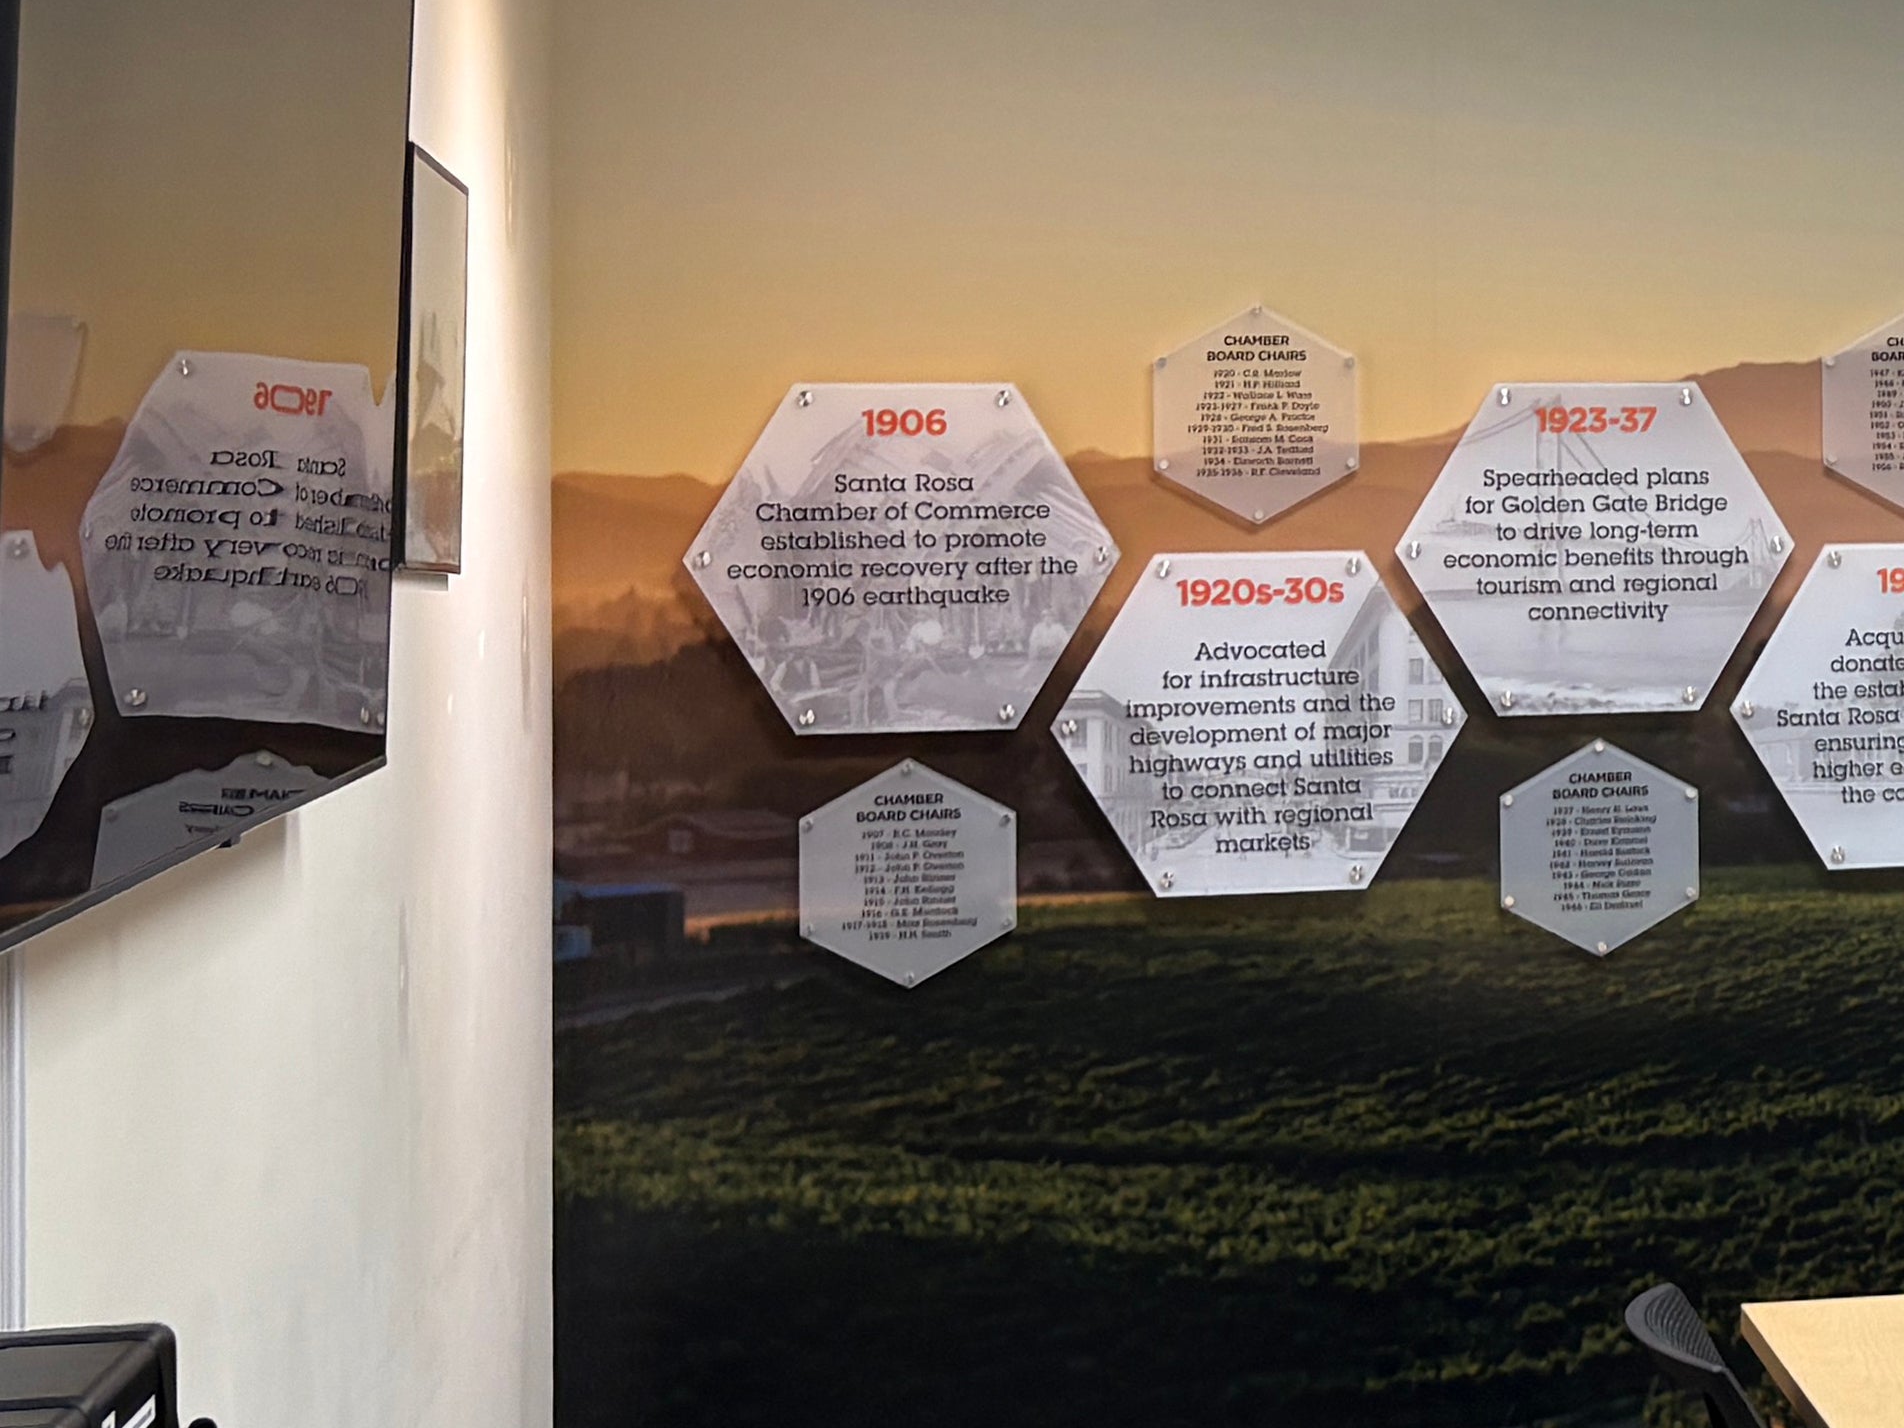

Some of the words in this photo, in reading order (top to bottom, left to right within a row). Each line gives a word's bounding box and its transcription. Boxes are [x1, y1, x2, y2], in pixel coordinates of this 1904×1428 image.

[1207, 350, 1255, 362] BOARD
[862, 408, 948, 438] 1906
[1534, 407, 1657, 434] 1923-37
[833, 473, 906, 491] Santa
[915, 473, 975, 490] Rosa
[1481, 467, 1638, 490] Spearheaded
[1646, 467, 1710, 489] plans
[754, 502, 876, 521] Chamber
[884, 502, 906, 520] of
[914, 501, 1051, 519] Commerce
[1464, 496, 1494, 513] for
[1501, 495, 1585, 513] Golden
[1592, 494, 1647, 512] Gate
[1655, 493, 1729, 515] Bridge
[760, 530, 905, 549] established
[914, 530, 936, 547] to
[944, 528, 1047, 551] promote
[800, 587, 854, 604] 1906
[862, 585, 1011, 608] earthquake
[1176, 577, 1345, 607] 1920s-30s
[1527, 600, 1669, 624] connectivity
[1193, 639, 1327, 658] Advocated
[1161, 670, 1192, 688] for
[1200, 667, 1360, 687] infrastructure
[1125, 695, 1295, 720] improvements
[1302, 694, 1350, 712] and
[1359, 693, 1397, 711] the
[1776, 707, 1839, 726] Santa
[1847, 705, 1899, 724] Rosa
[1552, 786, 1598, 800] BOARD
[1840, 784, 1875, 802] the
[856, 809, 906, 823] BOARD
[1149, 808, 1206, 826] Rosa
[1214, 806, 1266, 825] with
[1274, 803, 1374, 828] regional
[1215, 832, 1312, 851] markets
